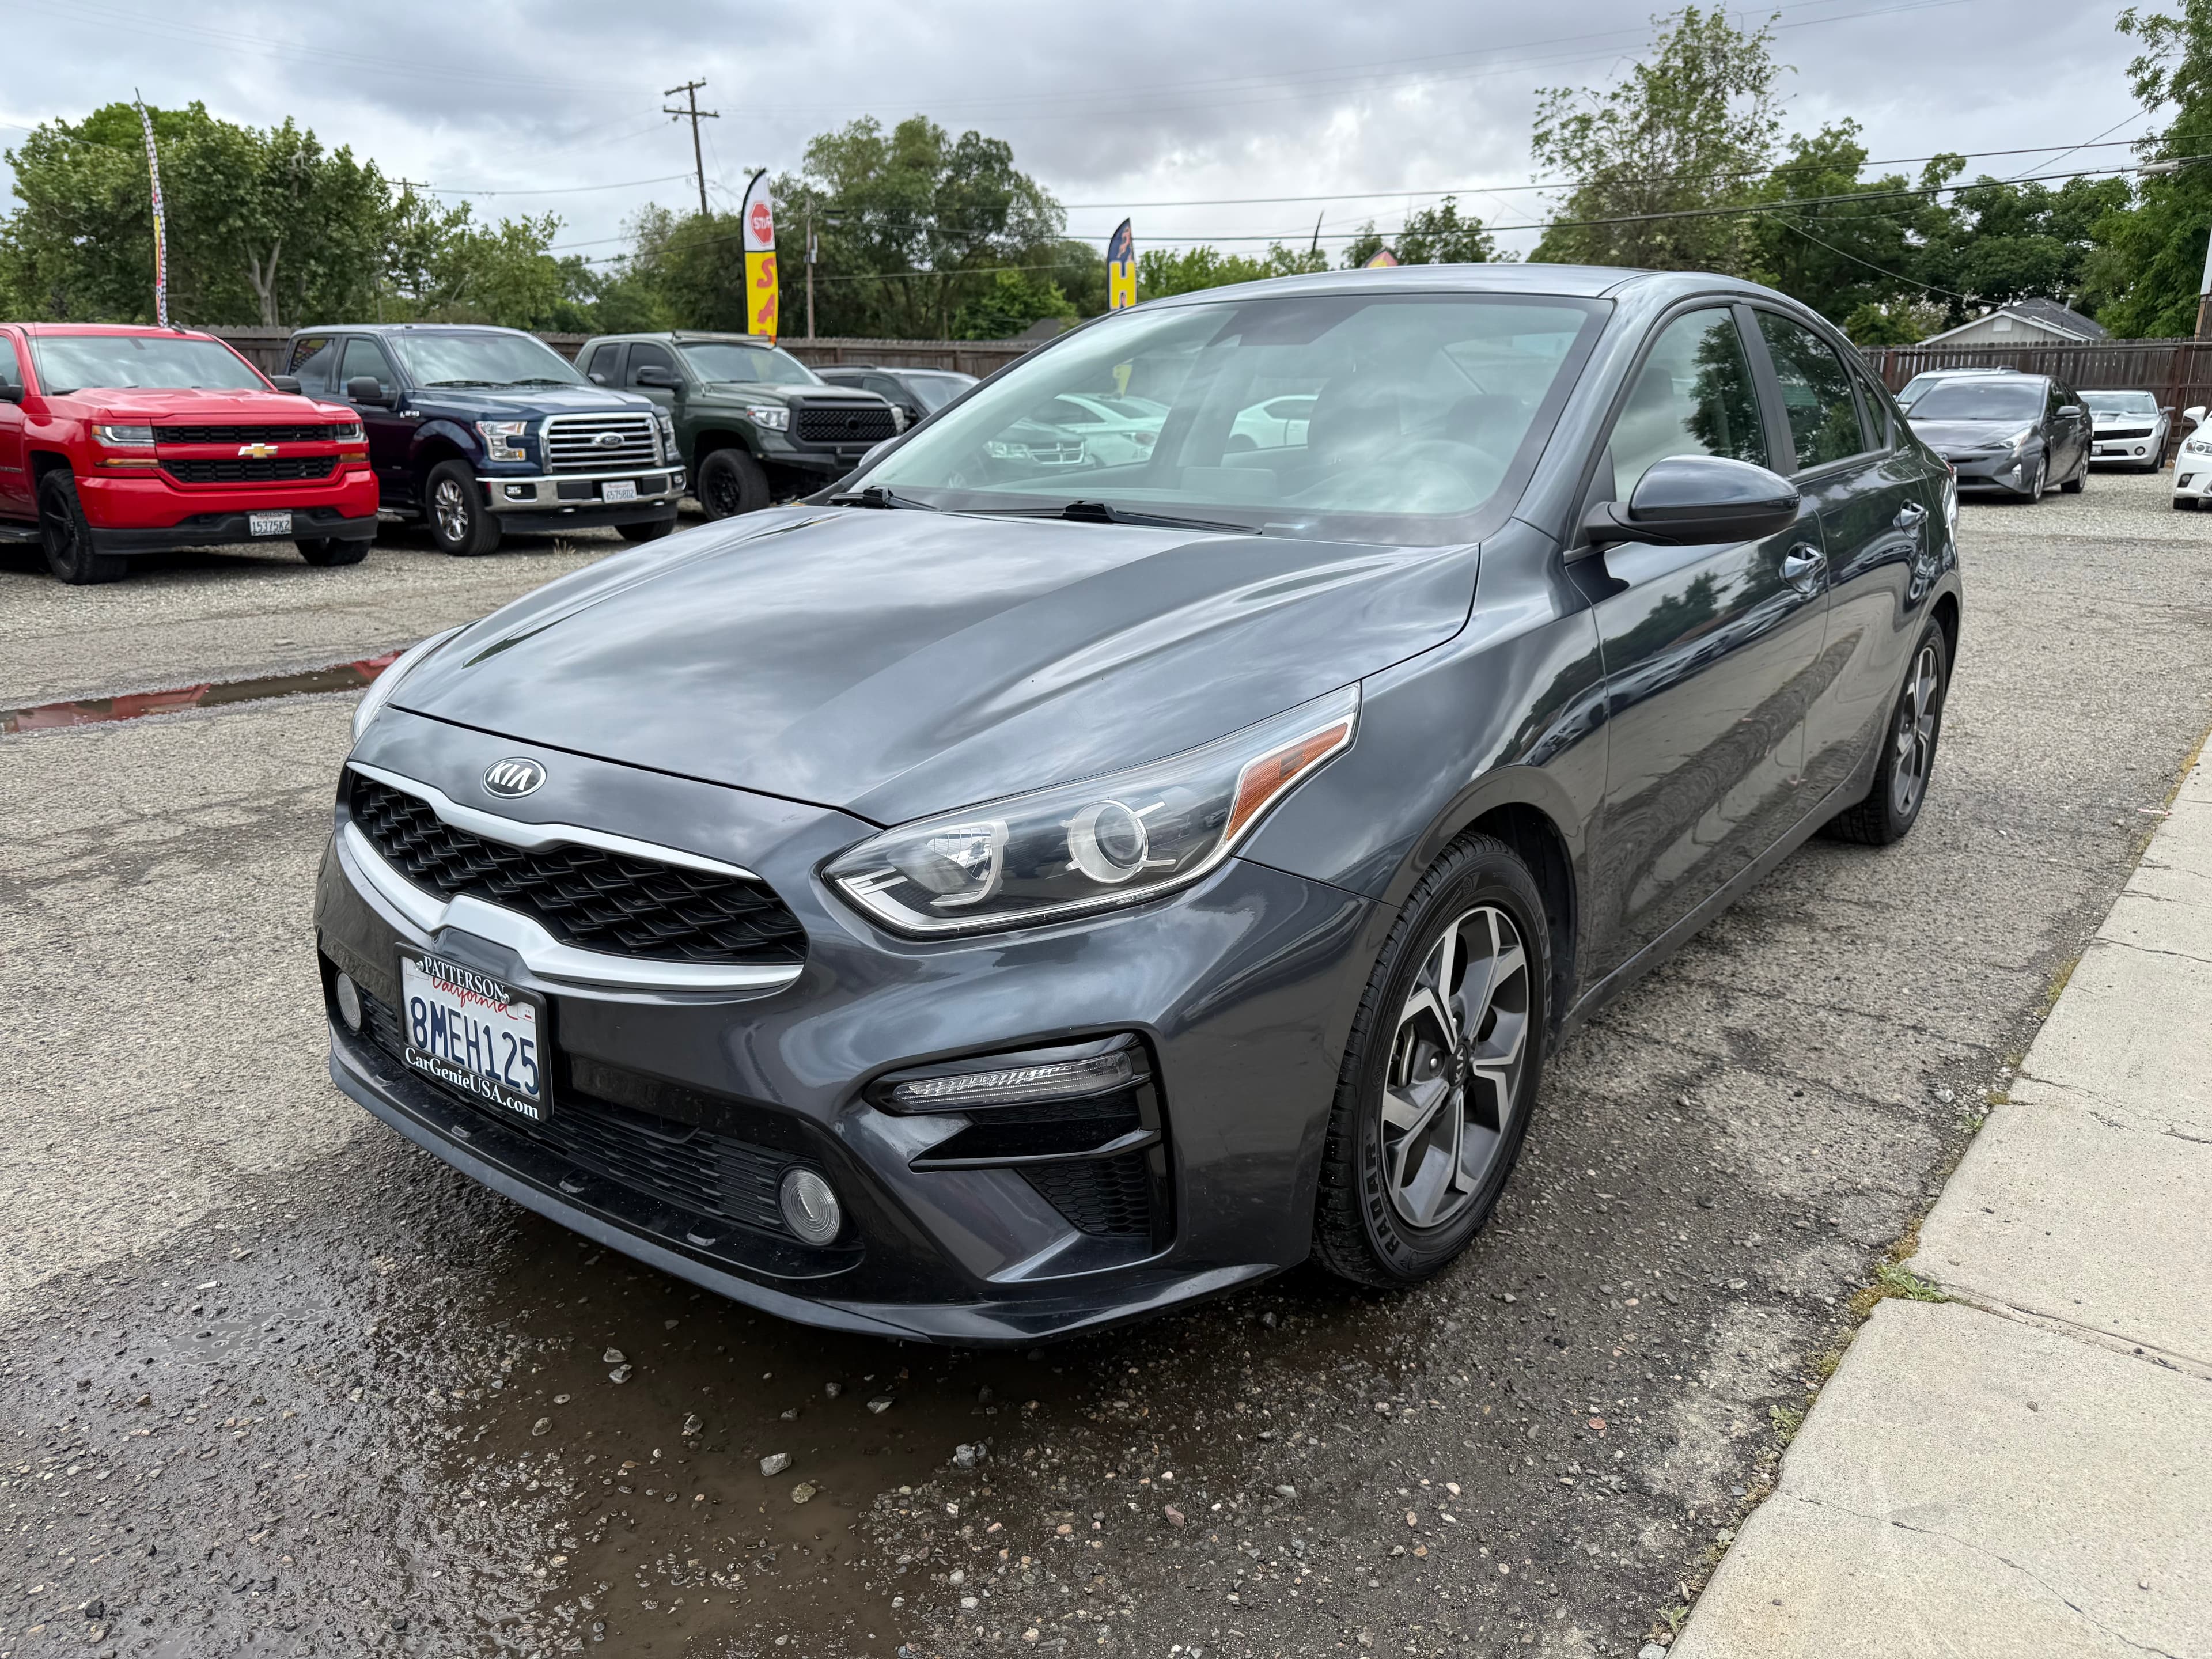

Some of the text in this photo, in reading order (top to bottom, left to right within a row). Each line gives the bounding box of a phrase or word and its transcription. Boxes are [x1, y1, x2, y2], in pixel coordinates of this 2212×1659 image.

[252, 520, 290, 532] 15375K2
[487, 762, 533, 791] KIA
[423, 955, 506, 1001] PATTERSON
[410, 997, 539, 1095] 8MEH125
[1455, 1047, 1464, 1083] KIA
[405, 1047, 539, 1120] CarGenieUSA.com
[1365, 1143, 1400, 1257] RADAR
